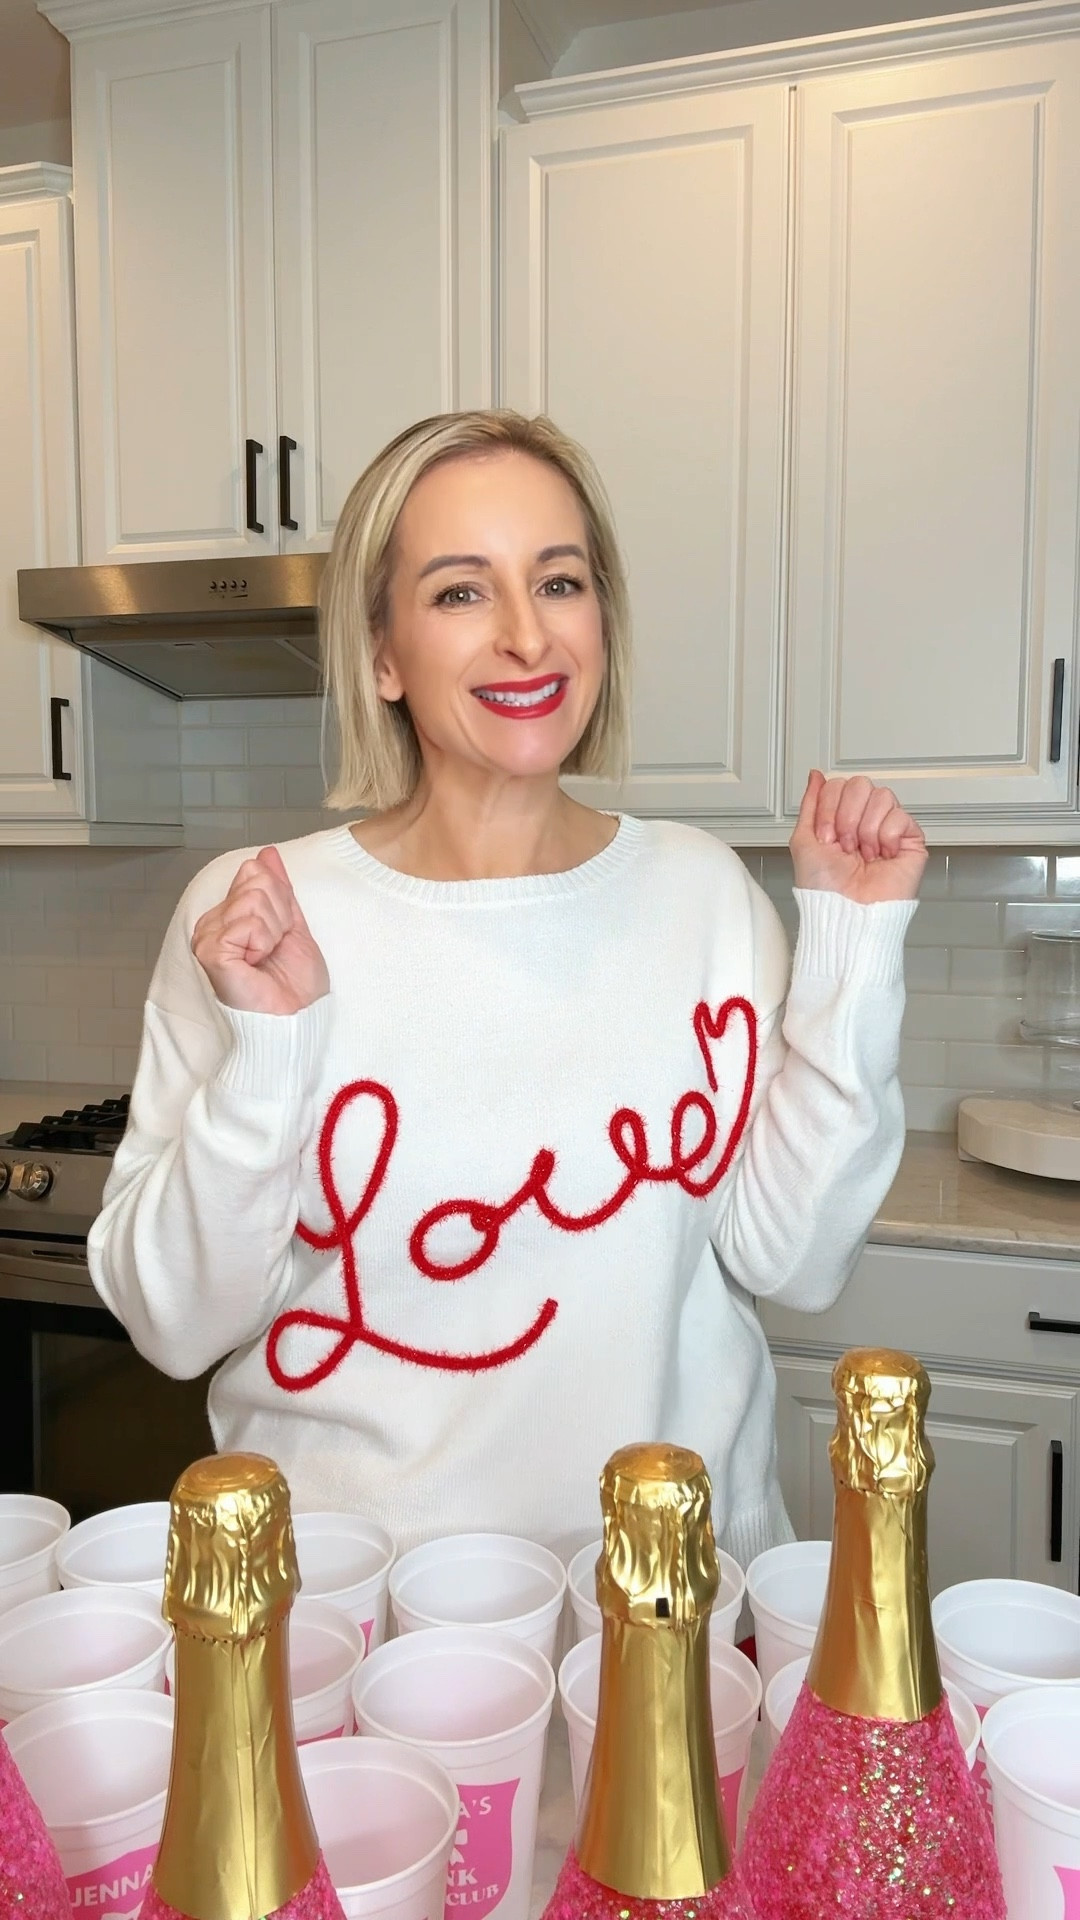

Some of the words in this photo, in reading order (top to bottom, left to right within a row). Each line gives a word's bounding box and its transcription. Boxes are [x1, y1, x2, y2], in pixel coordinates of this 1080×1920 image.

[265, 996, 757, 1391] Love
[459, 1796, 492, 1818] A'S
[445, 1884, 499, 1906] CLUB
